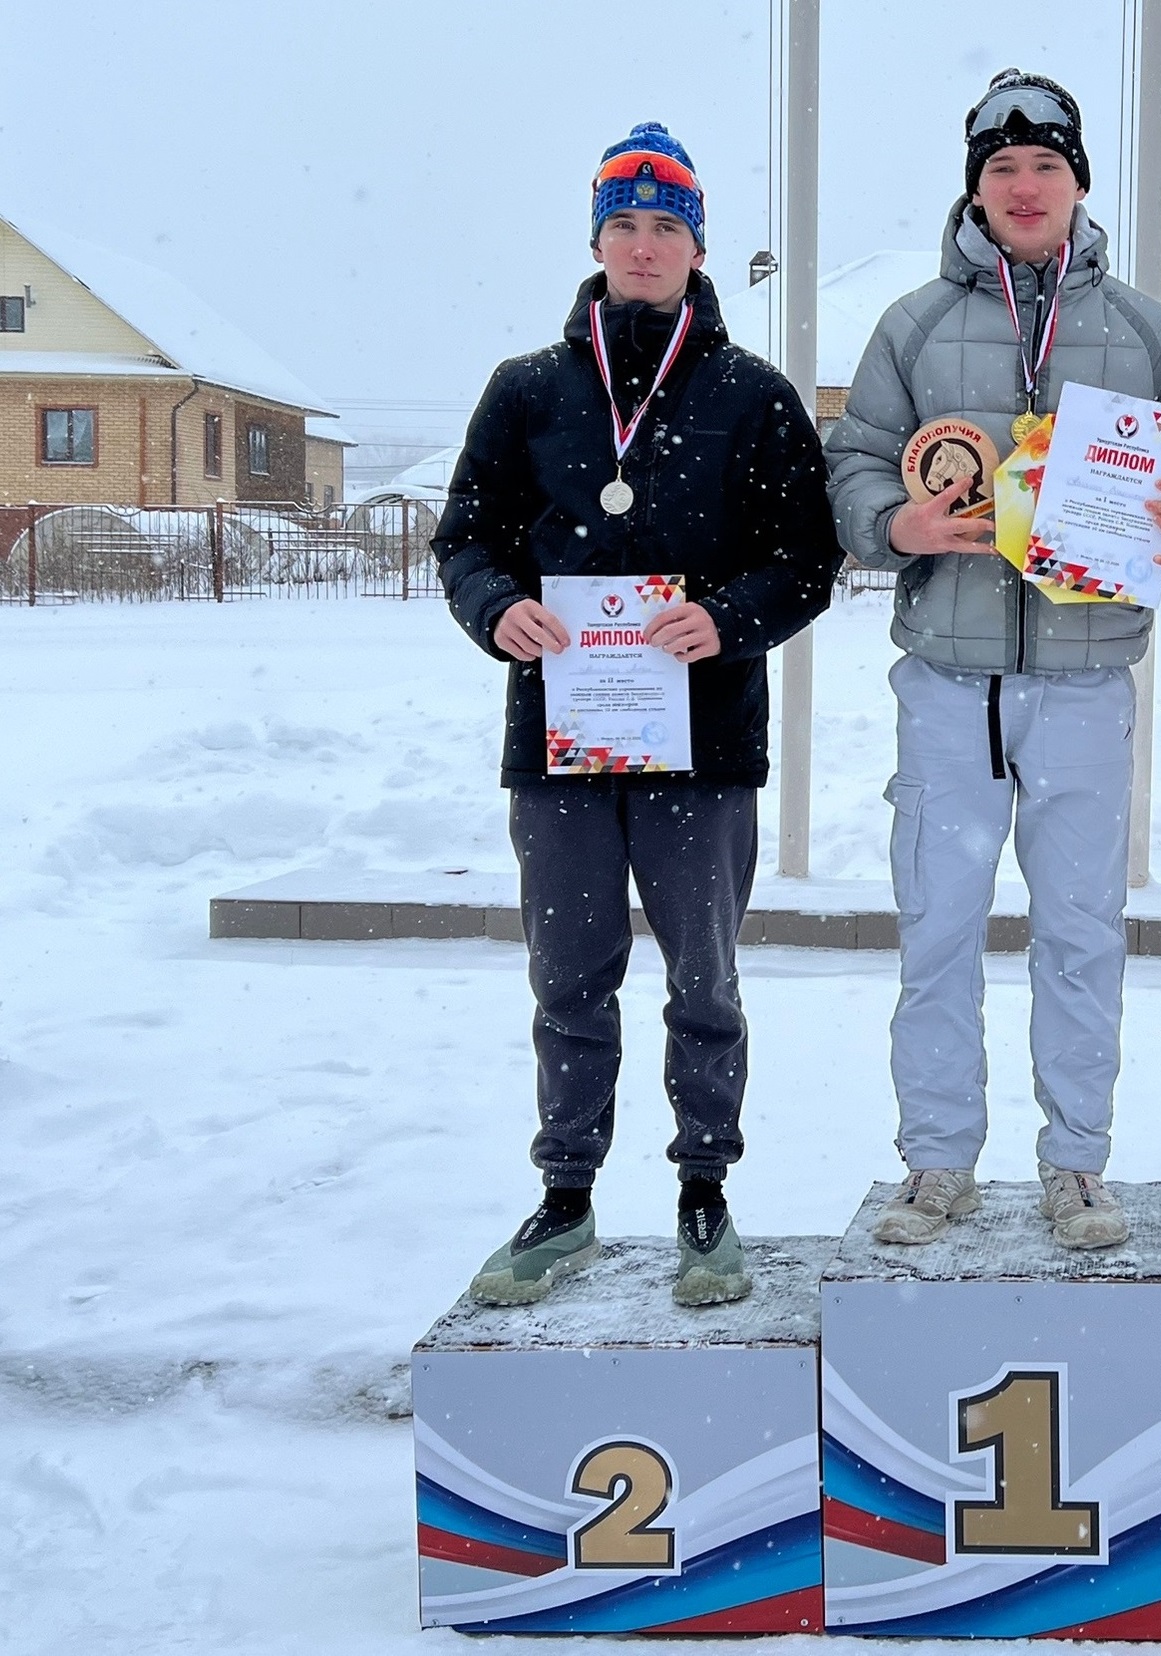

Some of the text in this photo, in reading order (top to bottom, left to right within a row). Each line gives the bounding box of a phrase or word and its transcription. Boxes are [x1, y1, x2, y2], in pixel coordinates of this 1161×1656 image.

[907, 425, 981, 472] БЛАГОПОЛУЧИЯ
[1084, 444, 1156, 474] ДИПЛОМ
[1090, 469, 1143, 485] НАГРАЖДАЕТСЯ
[580, 630, 650, 647] ДИПЛОМ
[953, 1370, 1101, 1556] 1
[571, 1440, 676, 1570] 2
